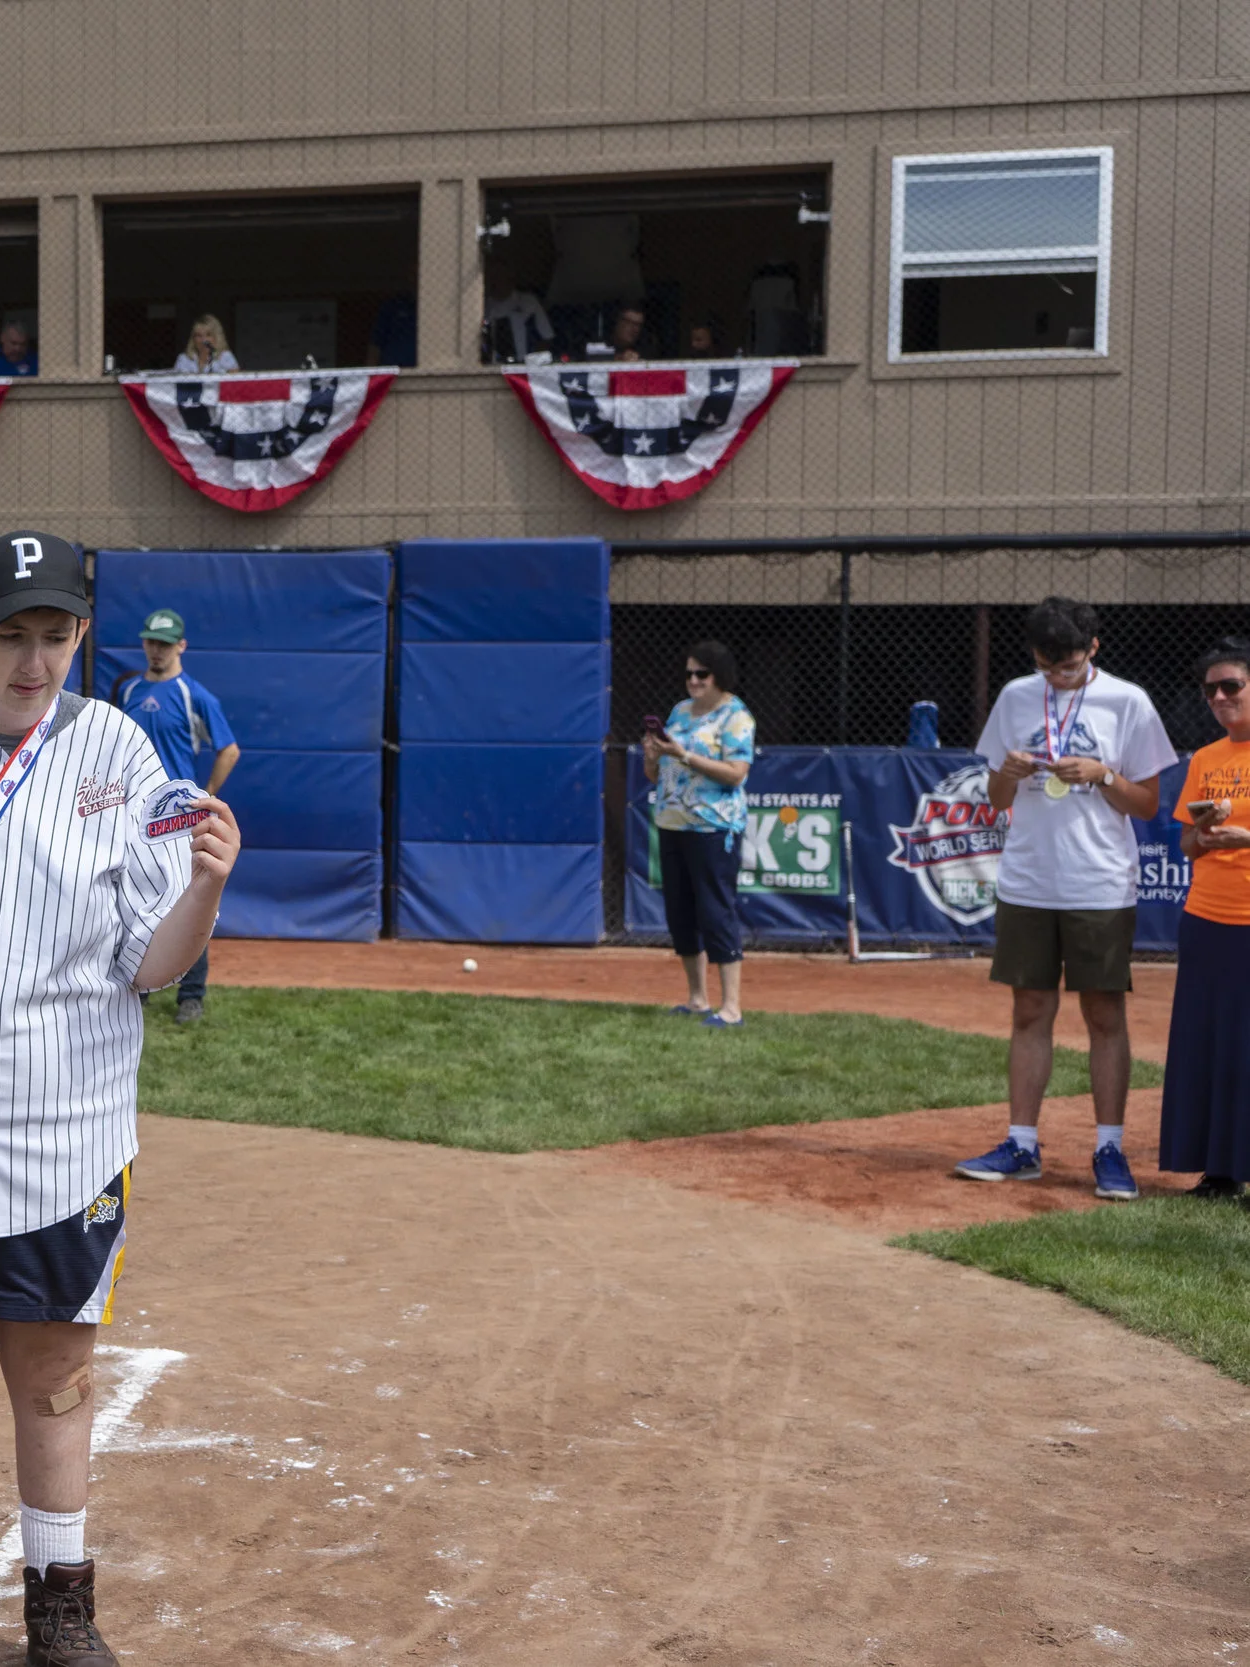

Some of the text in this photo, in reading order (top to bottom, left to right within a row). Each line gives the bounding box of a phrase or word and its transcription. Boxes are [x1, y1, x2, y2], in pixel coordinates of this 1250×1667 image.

[11, 537, 43, 579] P
[762, 793, 819, 808] STARTS
[821, 793, 842, 808] AT
[914, 836, 968, 862] WORLD
